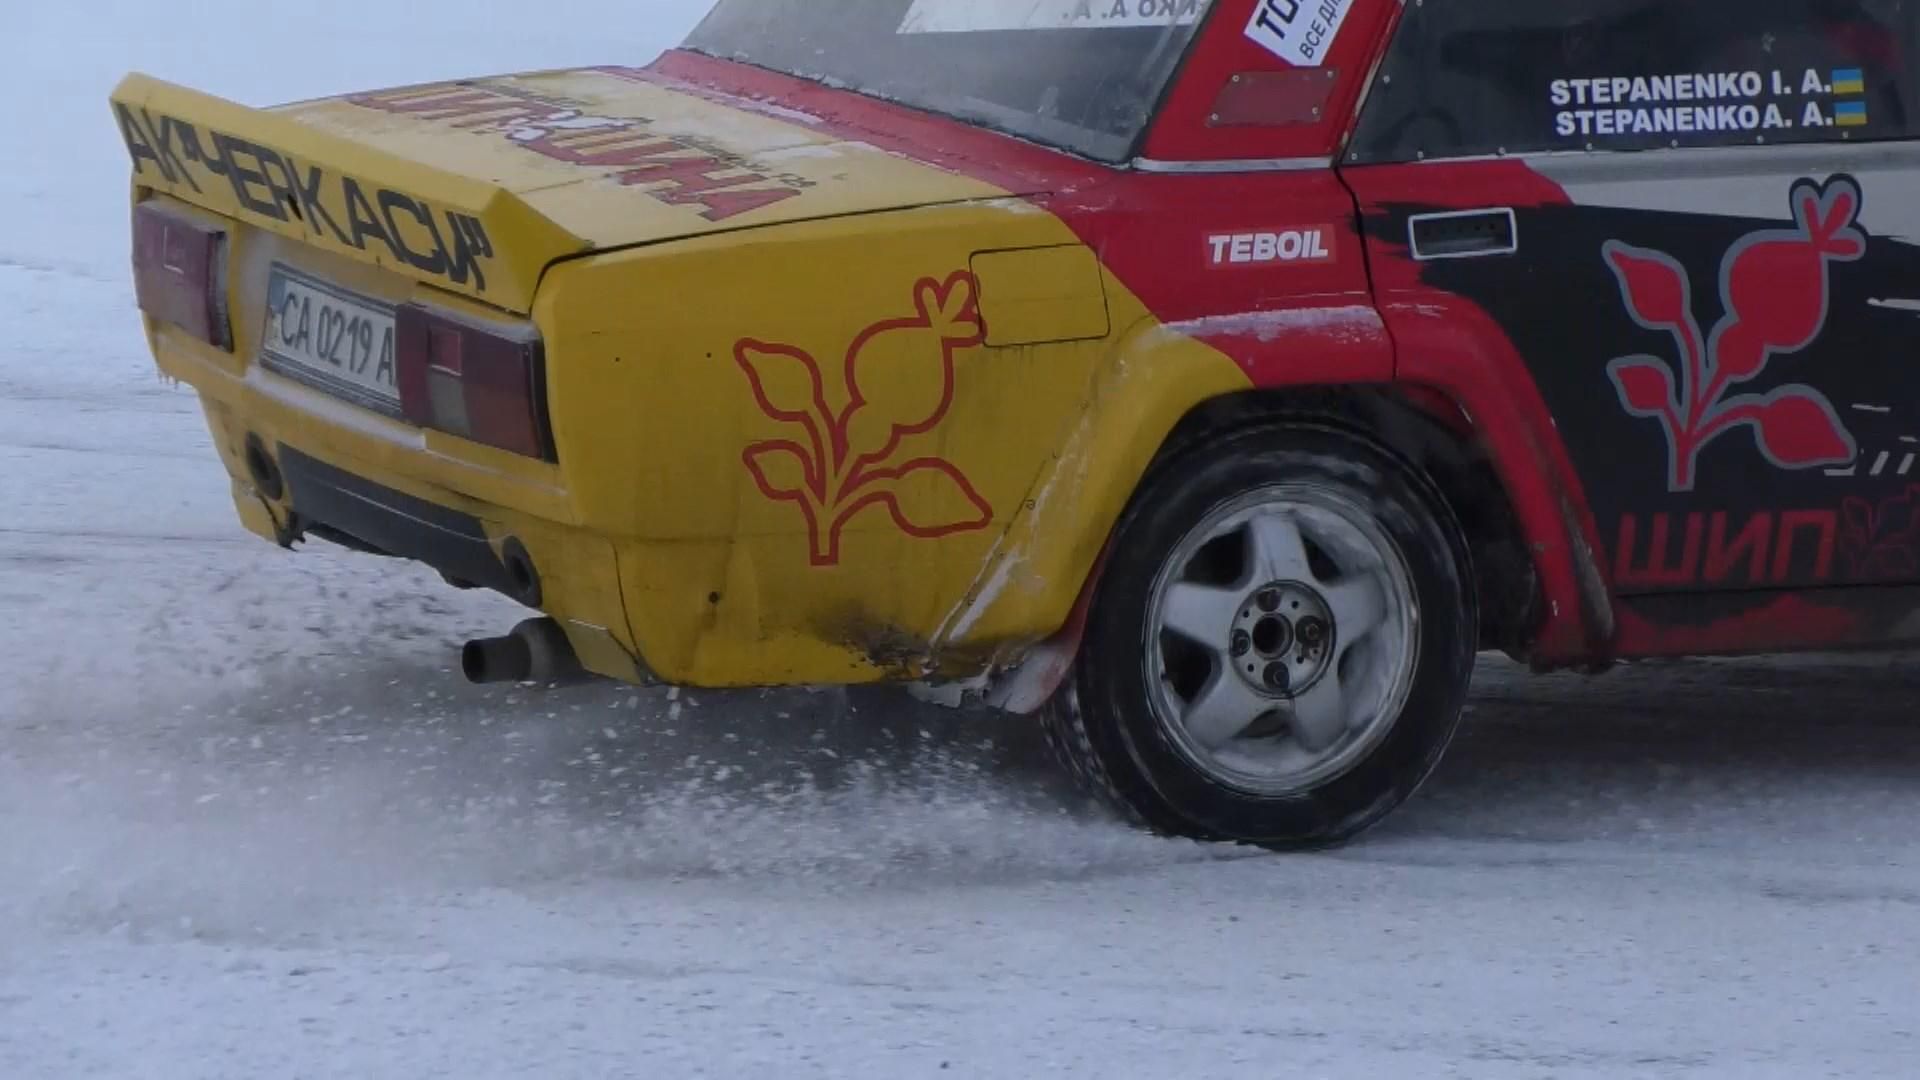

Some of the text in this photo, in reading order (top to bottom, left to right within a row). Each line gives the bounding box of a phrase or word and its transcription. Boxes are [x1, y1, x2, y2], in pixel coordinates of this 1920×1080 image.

[1256, 0, 1303, 39] ТО
[1300, 0, 1341, 59] ВСЕ ДЛ
[1550, 68, 1832, 105] STEPANENKO I. A.
[1556, 101, 1834, 136] STEPANENKO A. A.
[1208, 230, 1328, 264] TEBOIL
[281, 292, 310, 355] CA
[316, 305, 373, 375] 0219
[1614, 508, 1836, 586] ШИП
